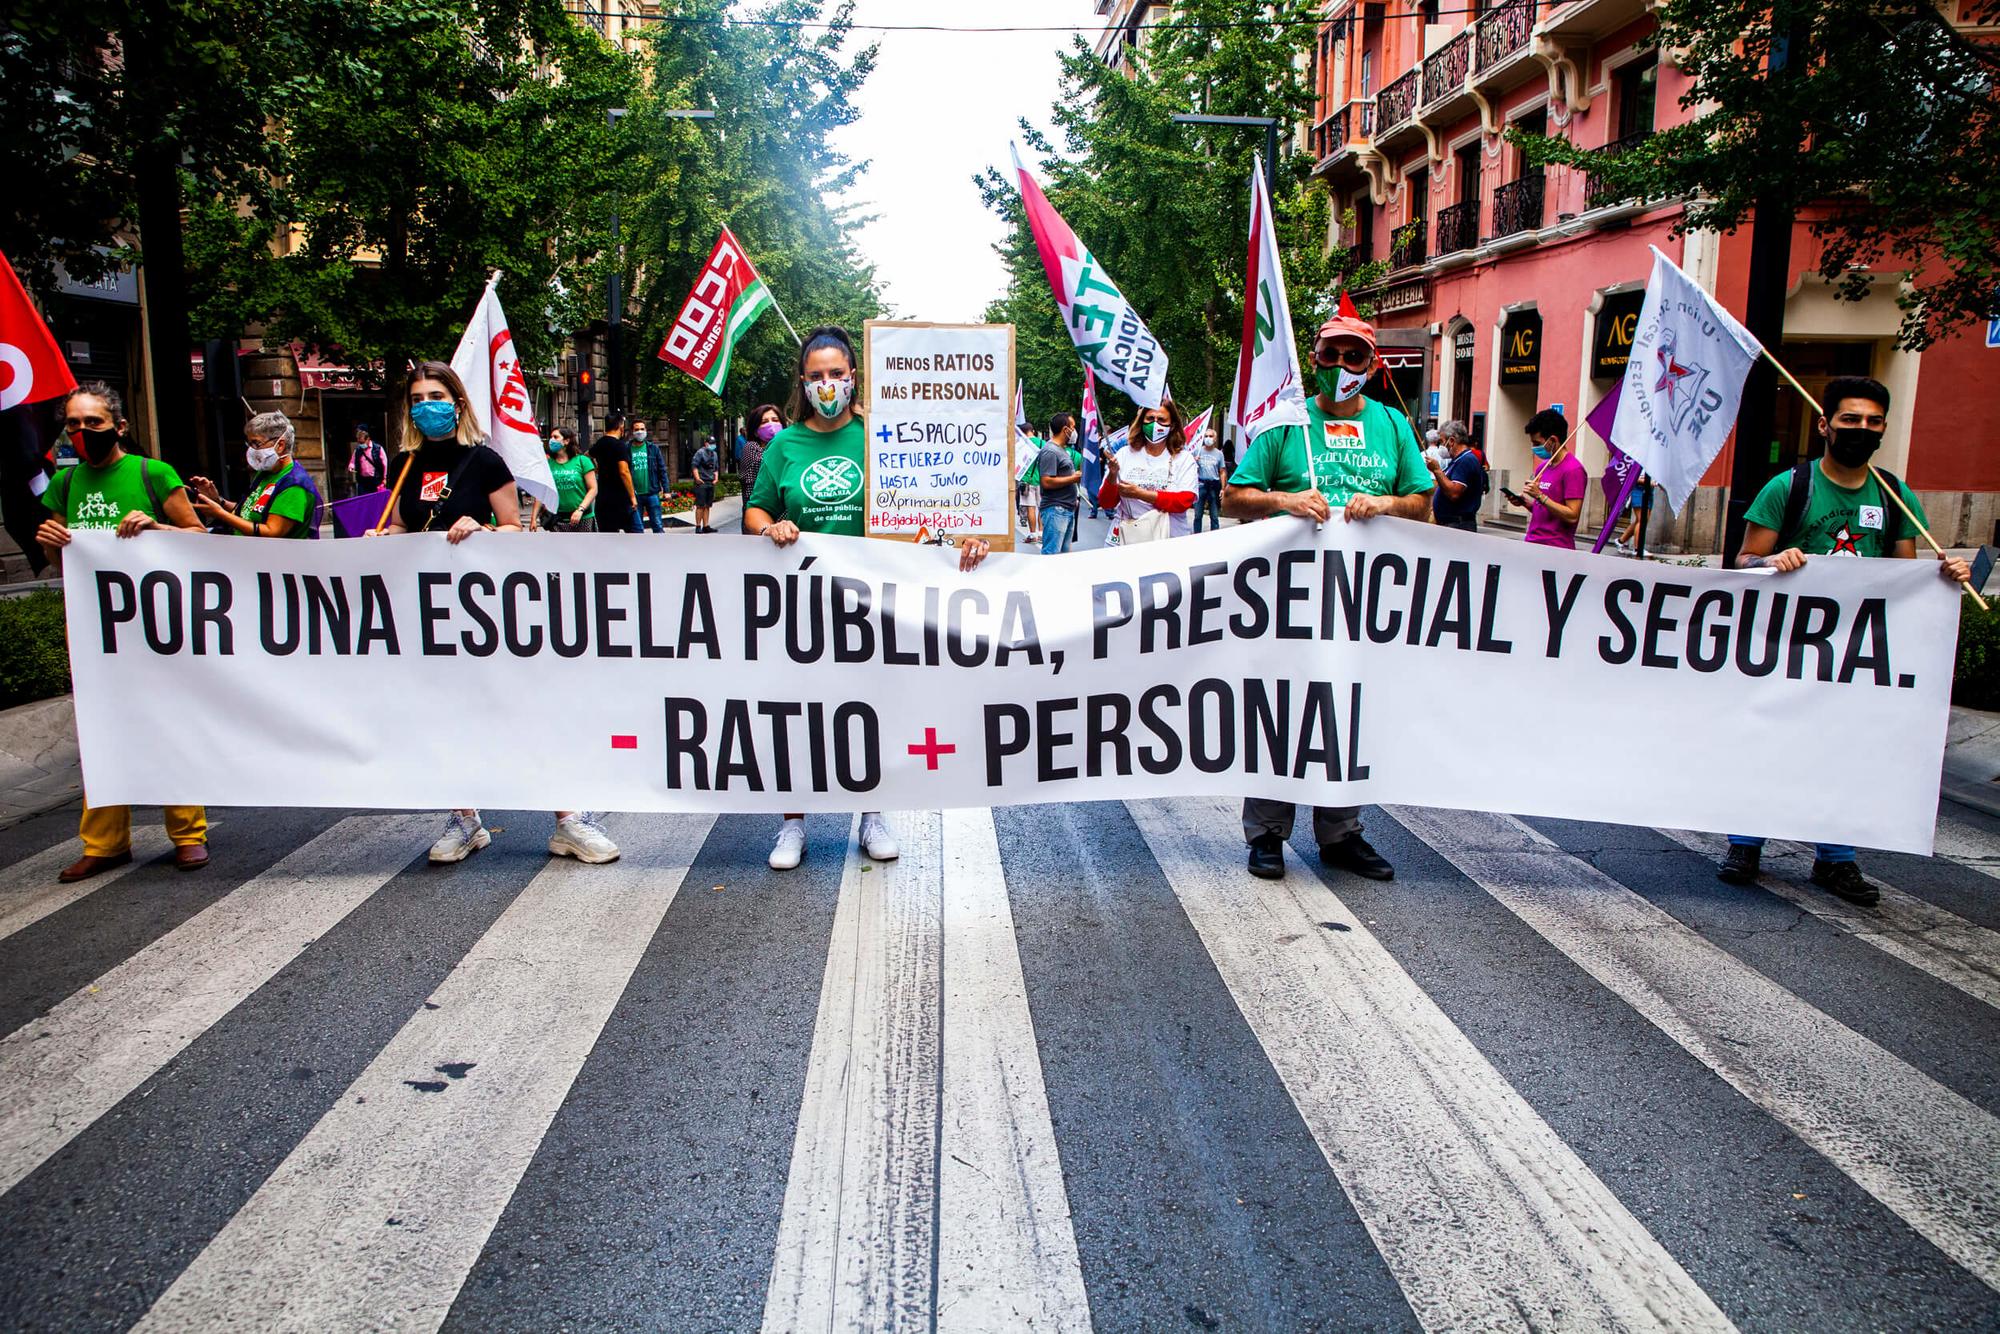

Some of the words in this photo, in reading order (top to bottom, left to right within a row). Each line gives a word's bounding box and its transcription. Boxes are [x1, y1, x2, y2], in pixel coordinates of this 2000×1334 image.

[1382, 284, 1424, 308] CAFETERIA
[886, 357, 930, 371] MENOS
[934, 354, 995, 371] RATIOS
[881, 383, 908, 399] MÁS
[912, 383, 999, 400] PERSONAL
[1329, 438, 1363, 447] USTEA
[879, 451, 954, 469] REFUERZO
[963, 451, 1001, 467] COVID
[880, 474, 918, 490] HASTA
[930, 471, 968, 488] JUNIO
[813, 489, 851, 498] PRIMARIA
[802, 505, 833, 514] Escuela
[834, 504, 863, 512] pública
[95, 569, 234, 656] POR
[256, 570, 400, 657] UNA
[417, 570, 723, 660] ESCUELA
[743, 556, 1065, 676] PÚBLICA,
[1091, 549, 1513, 661] PRESENCIAL
[1541, 570, 1588, 659] Y
[1598, 578, 1917, 689] SEGURA.
[664, 696, 882, 794] RATIO
[983, 677, 1371, 788] PERSONAL
